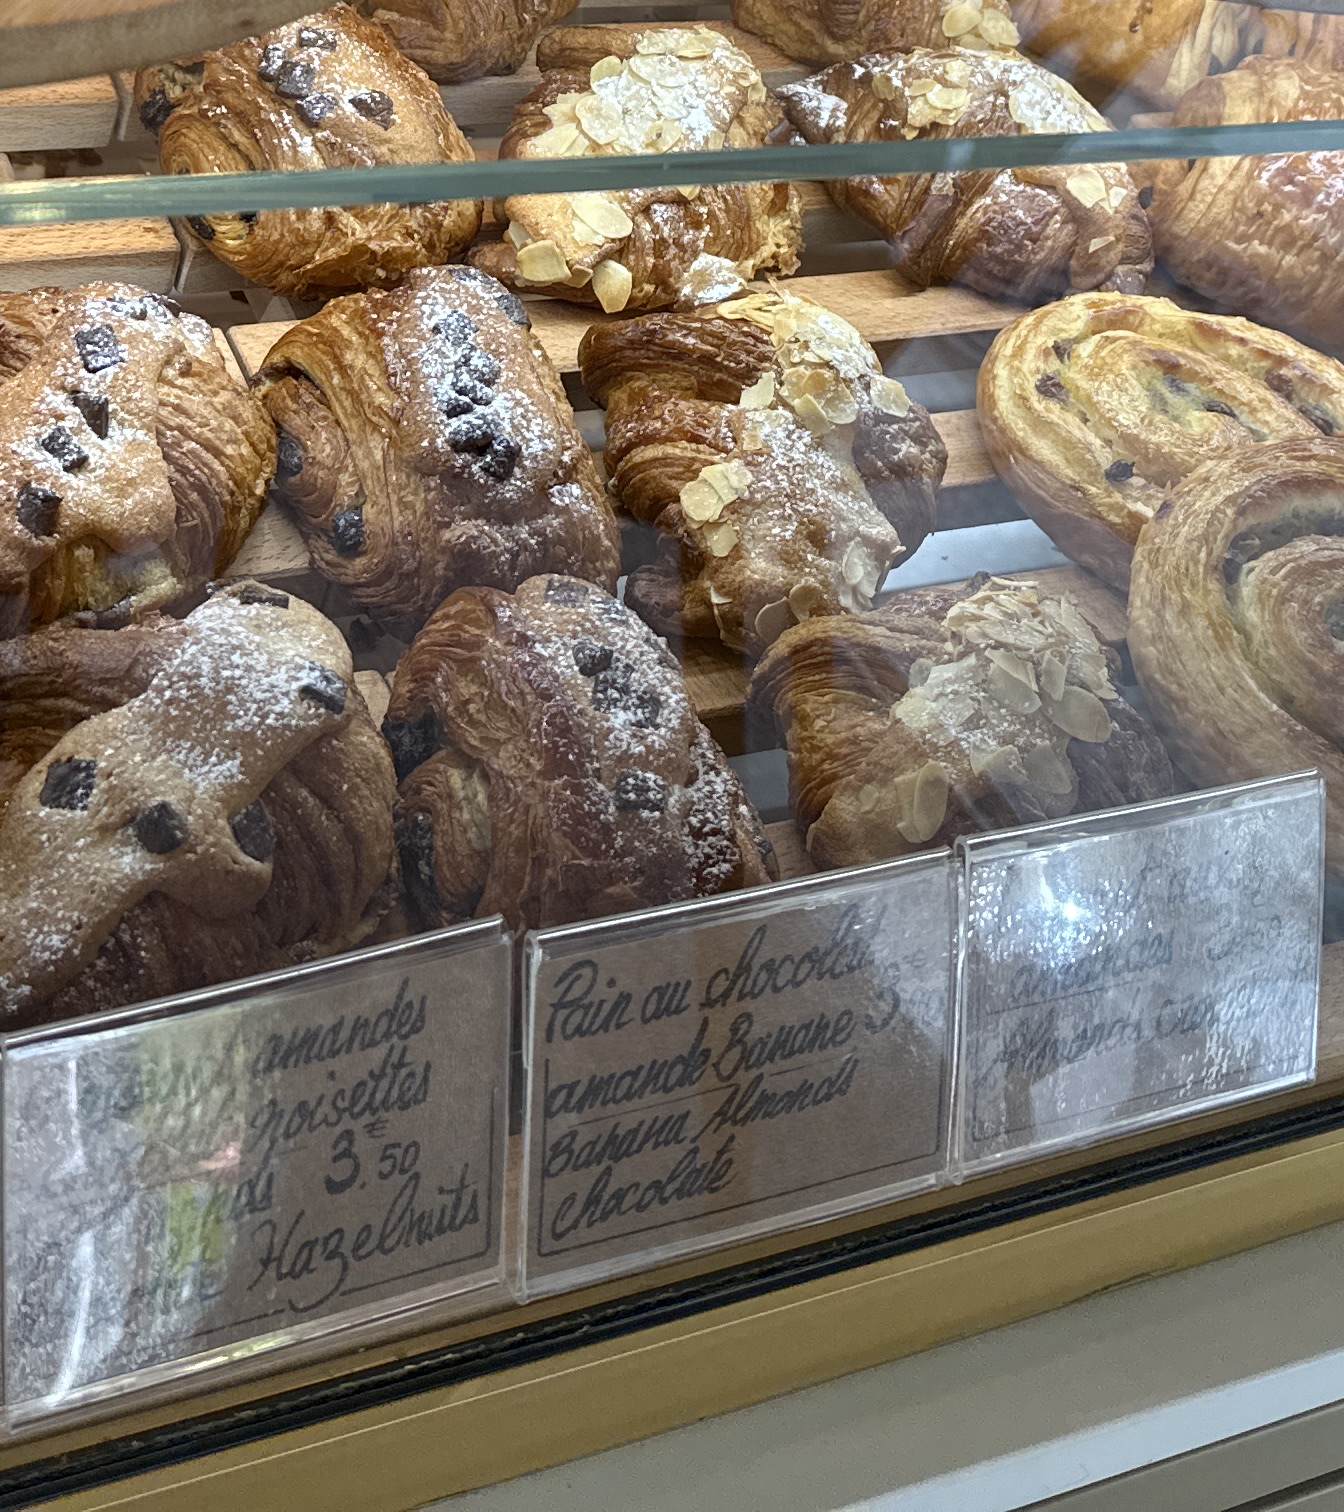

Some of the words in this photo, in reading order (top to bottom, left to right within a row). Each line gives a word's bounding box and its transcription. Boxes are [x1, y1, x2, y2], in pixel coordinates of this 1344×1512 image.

[253, 976, 427, 1078] amandes
[545, 959, 635, 1044] Pain
[640, 979, 692, 1026] au
[247, 1046, 433, 1157] noisettes
[546, 1016, 711, 1120] amande
[713, 1005, 856, 1083] Banane
[545, 1110, 696, 1180] Banana
[551, 1135, 739, 1243] chocolate
[246, 1163, 480, 1314] Hazelnuts
